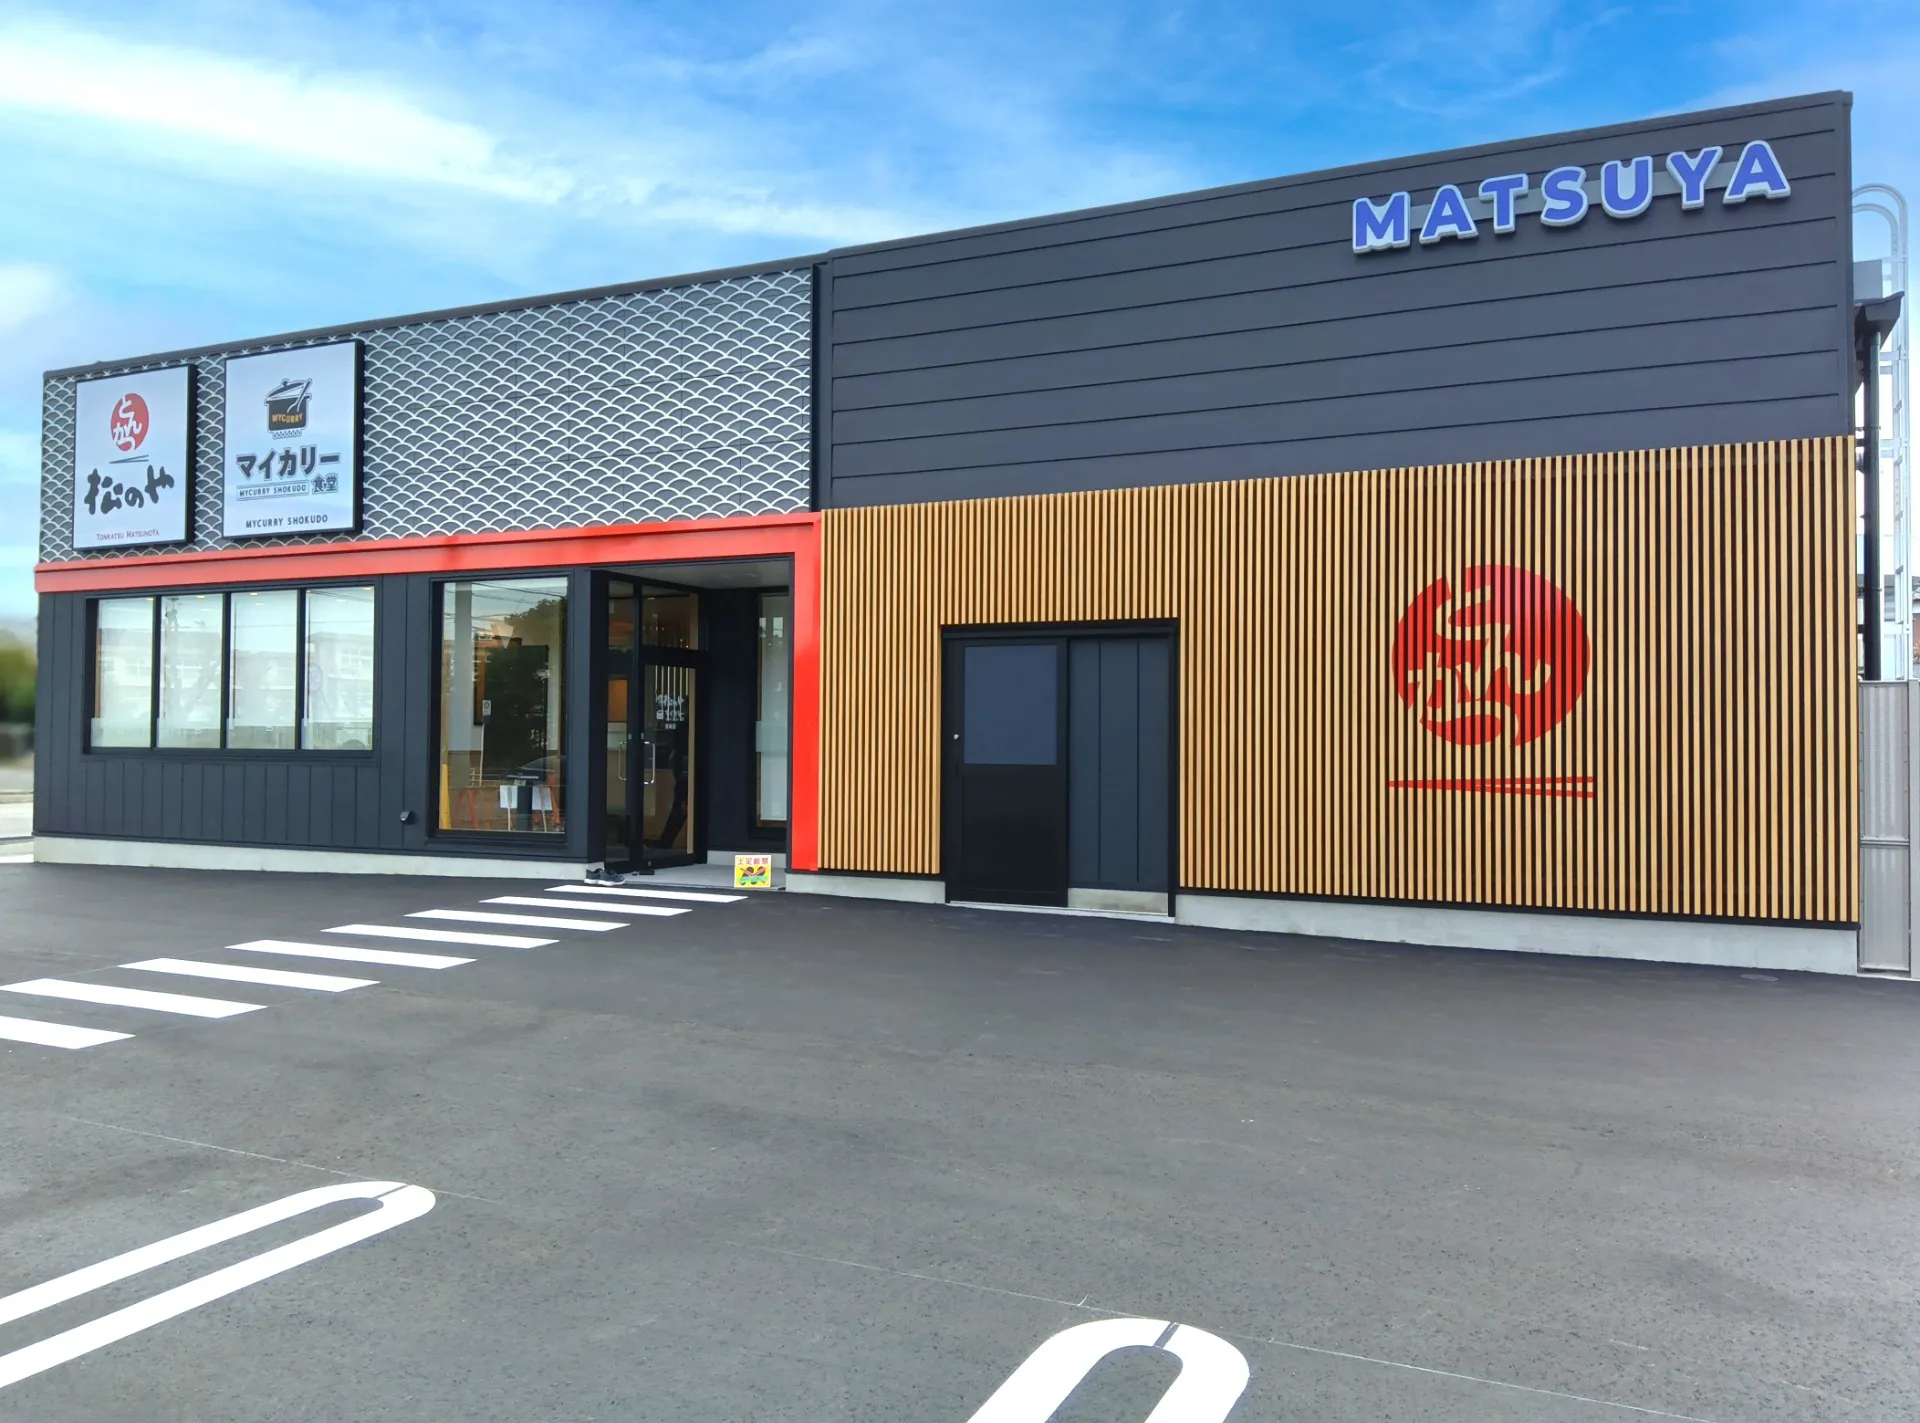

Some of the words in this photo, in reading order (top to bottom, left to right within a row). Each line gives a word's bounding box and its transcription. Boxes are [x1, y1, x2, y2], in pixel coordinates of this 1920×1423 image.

[1353, 140, 1791, 254] MATSUYA
[271, 413, 303, 424] MYCURRY
[236, 446, 340, 480] マイカリー
[84, 465, 175, 515] 松のや
[239, 487, 271, 497] MYCURRY
[273, 484, 307, 494] SHOKUDO
[312, 474, 338, 494] 食堂
[245, 518, 283, 528] MYCURRY
[287, 514, 328, 525] SHOKUDO
